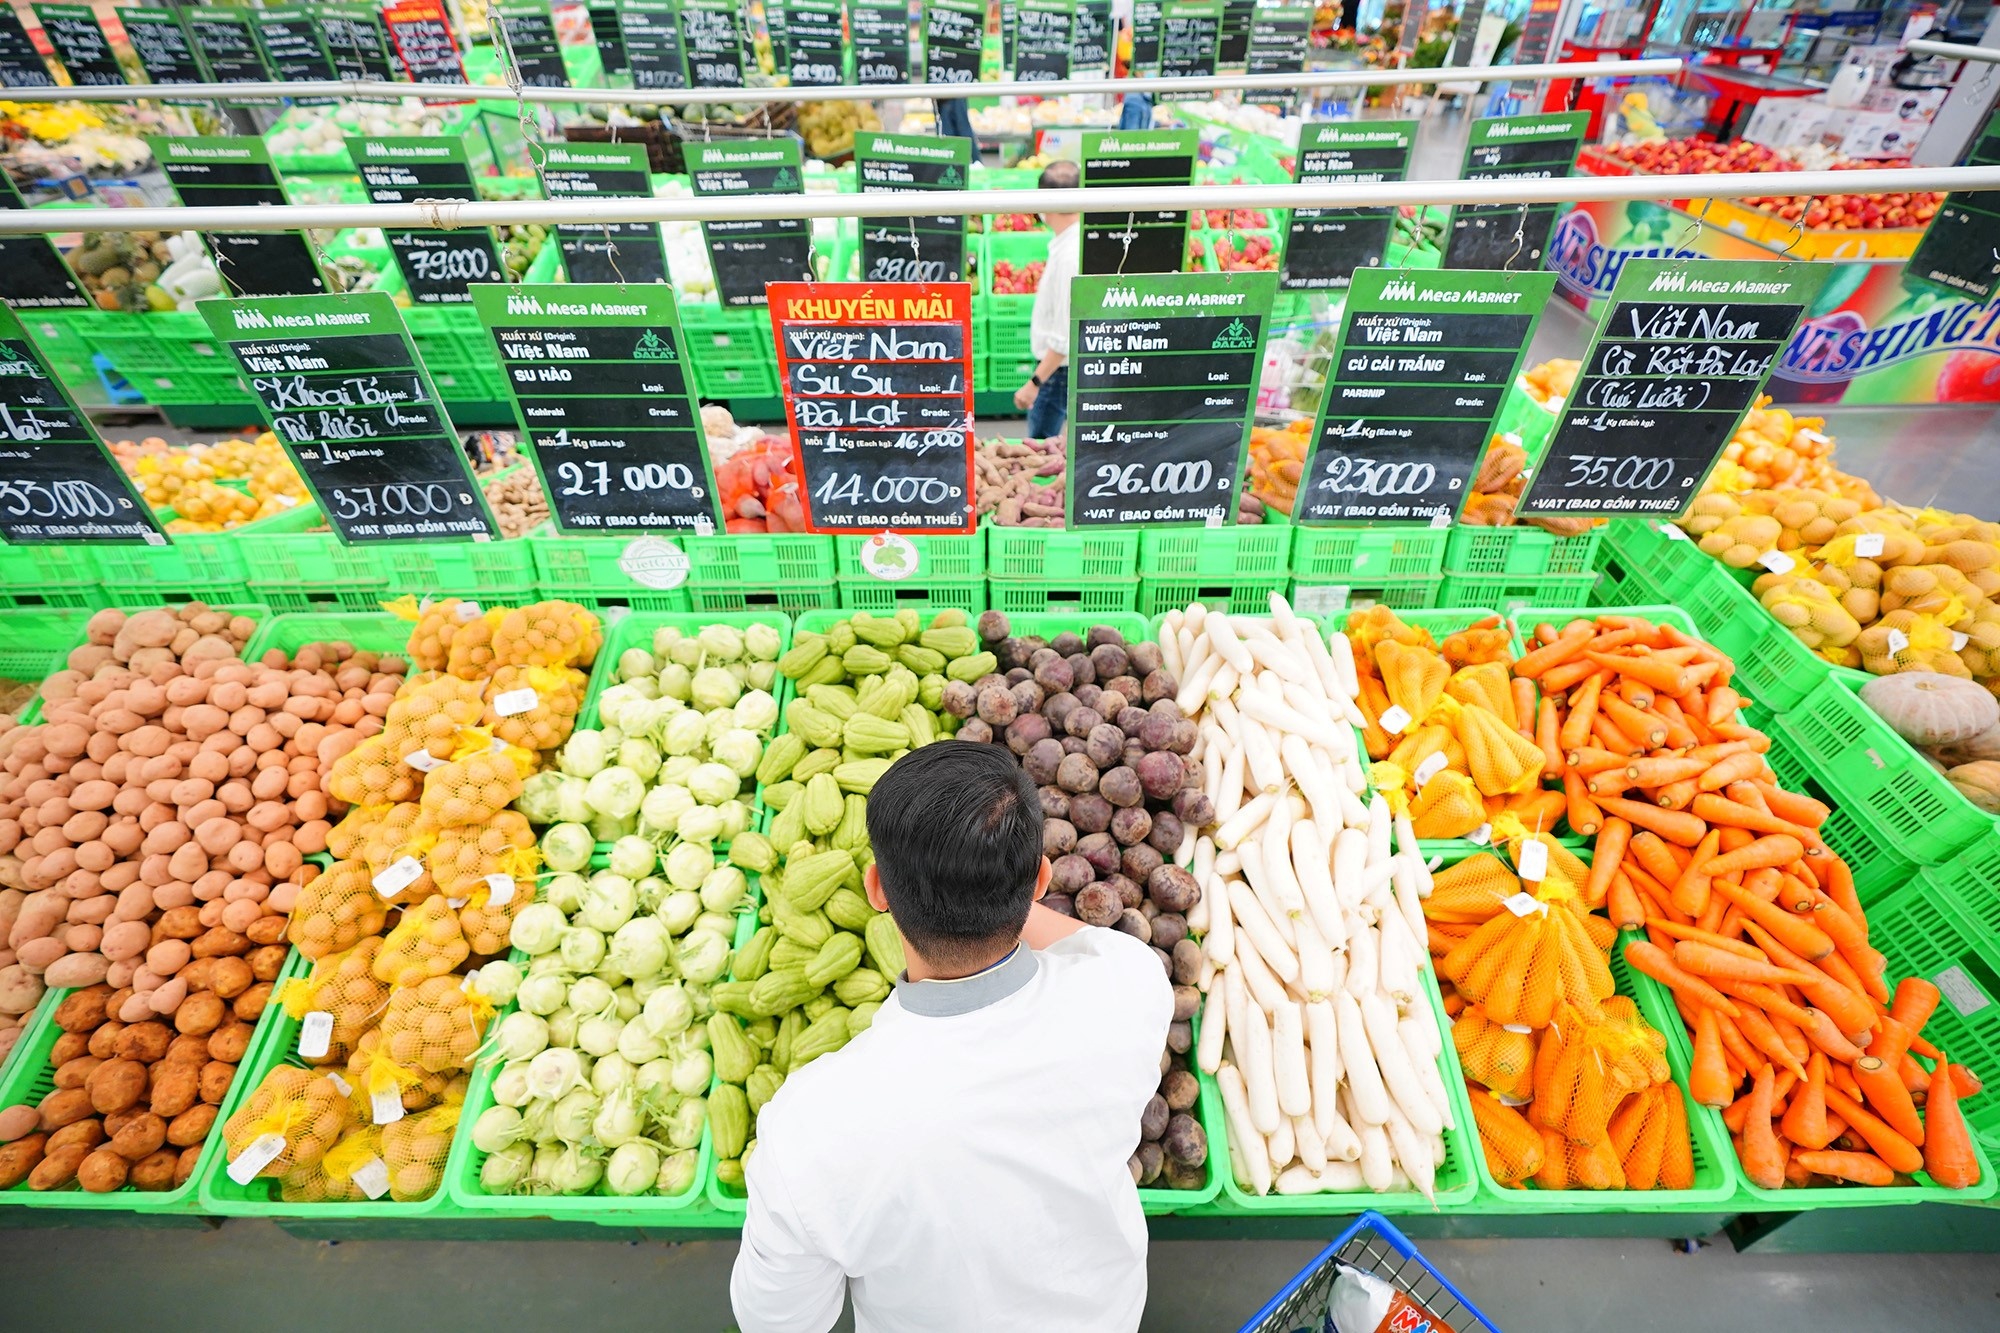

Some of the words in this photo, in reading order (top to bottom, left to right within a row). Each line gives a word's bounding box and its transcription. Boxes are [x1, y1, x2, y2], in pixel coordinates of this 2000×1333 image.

[408, 248, 488, 280] 79.000
[1687, 280, 1730, 292] Mega
[1730, 280, 1792, 294] Market
[787, 289, 896, 320] KHUYẾN
[904, 292, 953, 319] MÃI
[1141, 294, 1183, 307] Mega
[1185, 293, 1245, 306] Market
[1418, 289, 1461, 302] Mega
[1462, 290, 1522, 304] Market
[547, 303, 589, 316] Mega
[591, 303, 648, 316] Market
[272, 315, 314, 328] Mega
[315, 313, 371, 326] Market
[1085, 322, 1112, 334] XUẤT
[1114, 322, 1128, 334] XỨ
[1129, 322, 1161, 331] (Origin):
[1689, 305, 1760, 341] Nam
[1366, 327, 1400, 344] Việt
[1403, 327, 1442, 342] Nam
[504, 343, 545, 361] Việt
[545, 344, 590, 358] Nam
[869, 327, 954, 362] Nam
[1085, 336, 1122, 353] Việt
[1127, 335, 1168, 350] Nam
[1212, 340, 1255, 349] DALAT
[632, 350, 675, 359] DALAT
[244, 356, 285, 373] Việt
[288, 355, 329, 370] Nam
[1084, 359, 1104, 376] CỦ
[1109, 357, 1142, 375] DỀN
[1347, 355, 1367, 371] CỦ
[1370, 355, 1394, 372] CẢI
[1398, 354, 1445, 372] TRẮNG
[514, 369, 537, 382] SU
[540, 366, 572, 381] HÀO
[851, 364, 898, 396] Su
[1082, 403, 1122, 411] Beetroot
[1205, 397, 1234, 406] Grade:
[1342, 389, 1385, 398] PARSNIP
[1455, 398, 1484, 407] Grade:
[649, 408, 678, 416] Grade:
[921, 409, 950, 417] Grade:
[1606, 419, 1619, 427] Kg
[1117, 432, 1131, 442] Kg
[1361, 427, 1375, 439] Kg
[572, 439, 589, 449] Kg
[840, 438, 854, 449] Kg
[557, 460, 694, 496] 27.000
[1088, 460, 1213, 498] 26.000
[1564, 455, 1675, 490] 35.000
[815, 472, 949, 505] 14.000
[334, 484, 453, 519] 37.000
[1310, 505, 1341, 515] +VAT
[1344, 506, 1376, 516] (BAO
[1378, 502, 1410, 517] GỒM
[1412, 504, 1450, 517] THUẾ)
[1531, 498, 1567, 509] +VAT
[1566, 498, 1601, 510] (BAO
[1603, 495, 1638, 510] GỒM
[1640, 496, 1680, 511] THUẾ)
[571, 515, 601, 525] +VAT
[605, 515, 637, 526] (BAO
[640, 512, 671, 525] GỒM
[672, 512, 712, 525] THUẾ)
[823, 515, 853, 525] +VAT
[858, 515, 888, 525] (BAO
[891, 512, 921, 525] GỒM
[924, 512, 962, 525] THUẾ)
[1083, 508, 1114, 518] +VAT
[1120, 510, 1151, 521] (BAO
[1154, 505, 1184, 520] GỒM
[1188, 505, 1225, 518] THUẾ)
[350, 525, 380, 535] +VAT
[383, 523, 415, 535] (BAO
[416, 519, 447, 533] GỒM
[449, 517, 486, 532] THUẾ)
[626, 558, 684, 569] VietGAP
